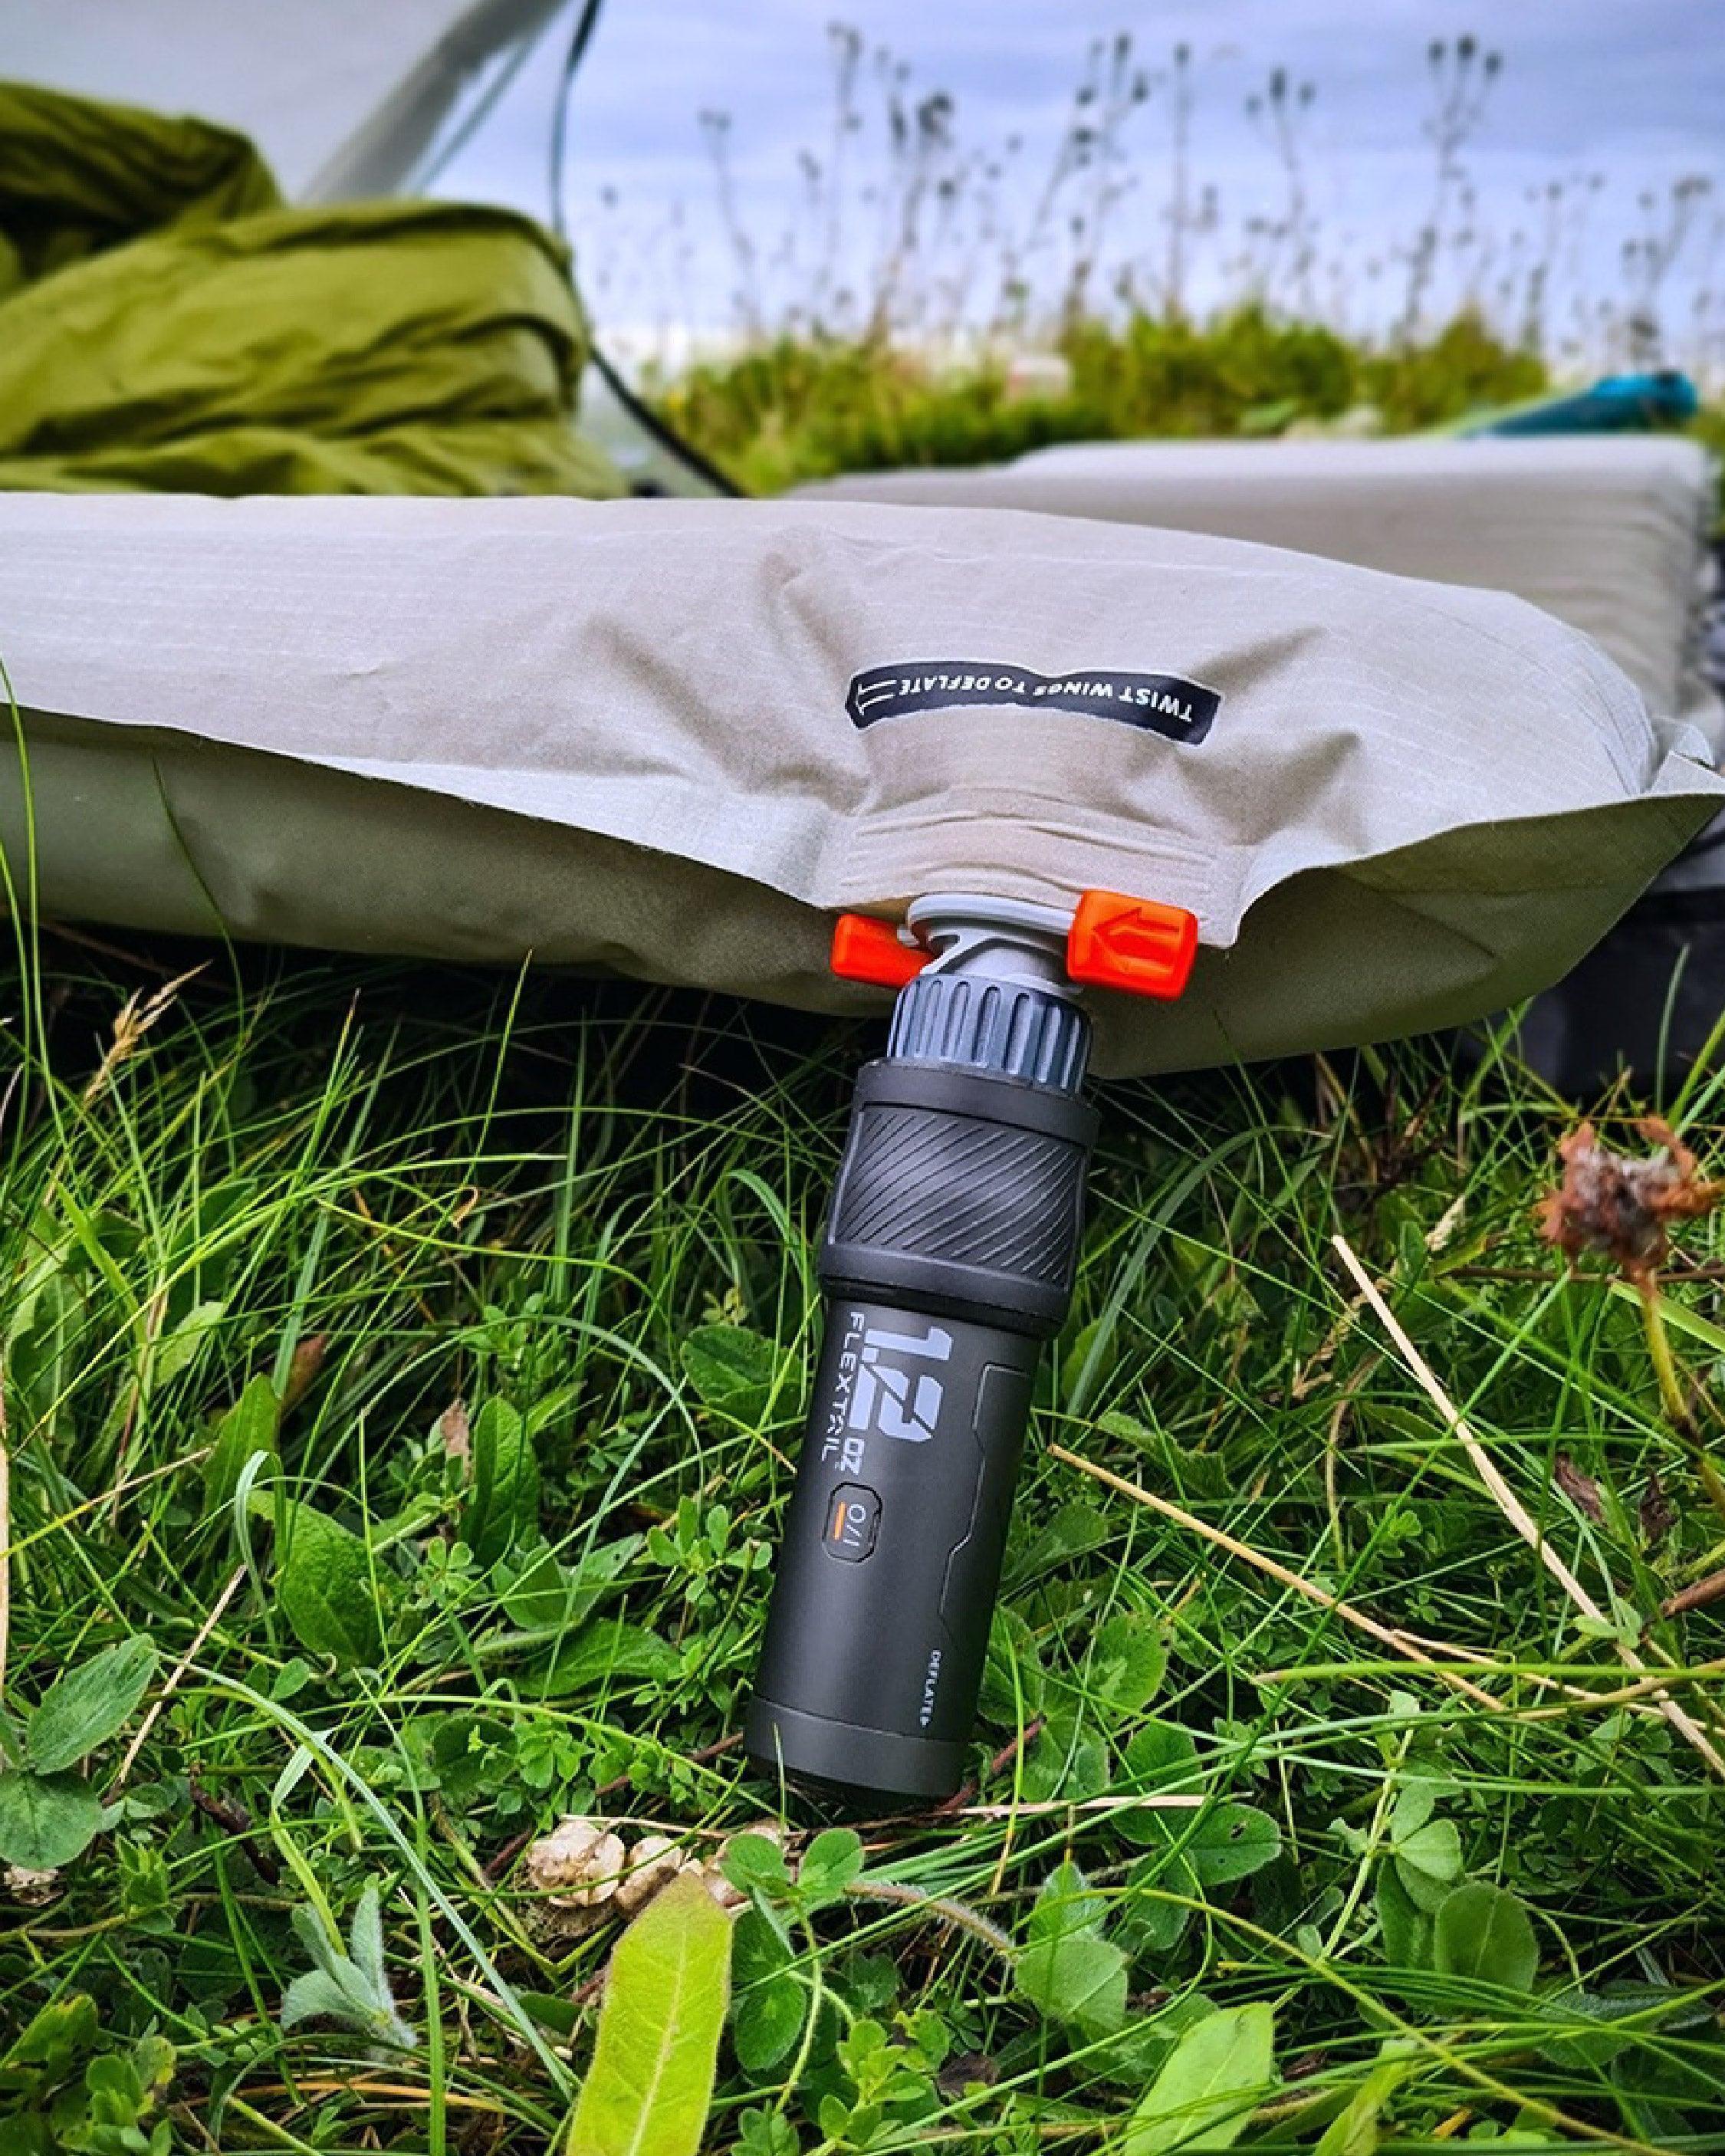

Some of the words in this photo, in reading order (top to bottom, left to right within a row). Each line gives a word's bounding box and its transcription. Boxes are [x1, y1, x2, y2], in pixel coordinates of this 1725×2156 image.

[899, 675, 991, 696] DEFLATE
[994, 676, 1024, 695] TO
[1118, 686, 1192, 722] TWIST
[822, 1312, 865, 1461] FLEXTAIL
[849, 1326, 954, 1441] 1.2
[920, 1649, 941, 1715] DEFLATE
